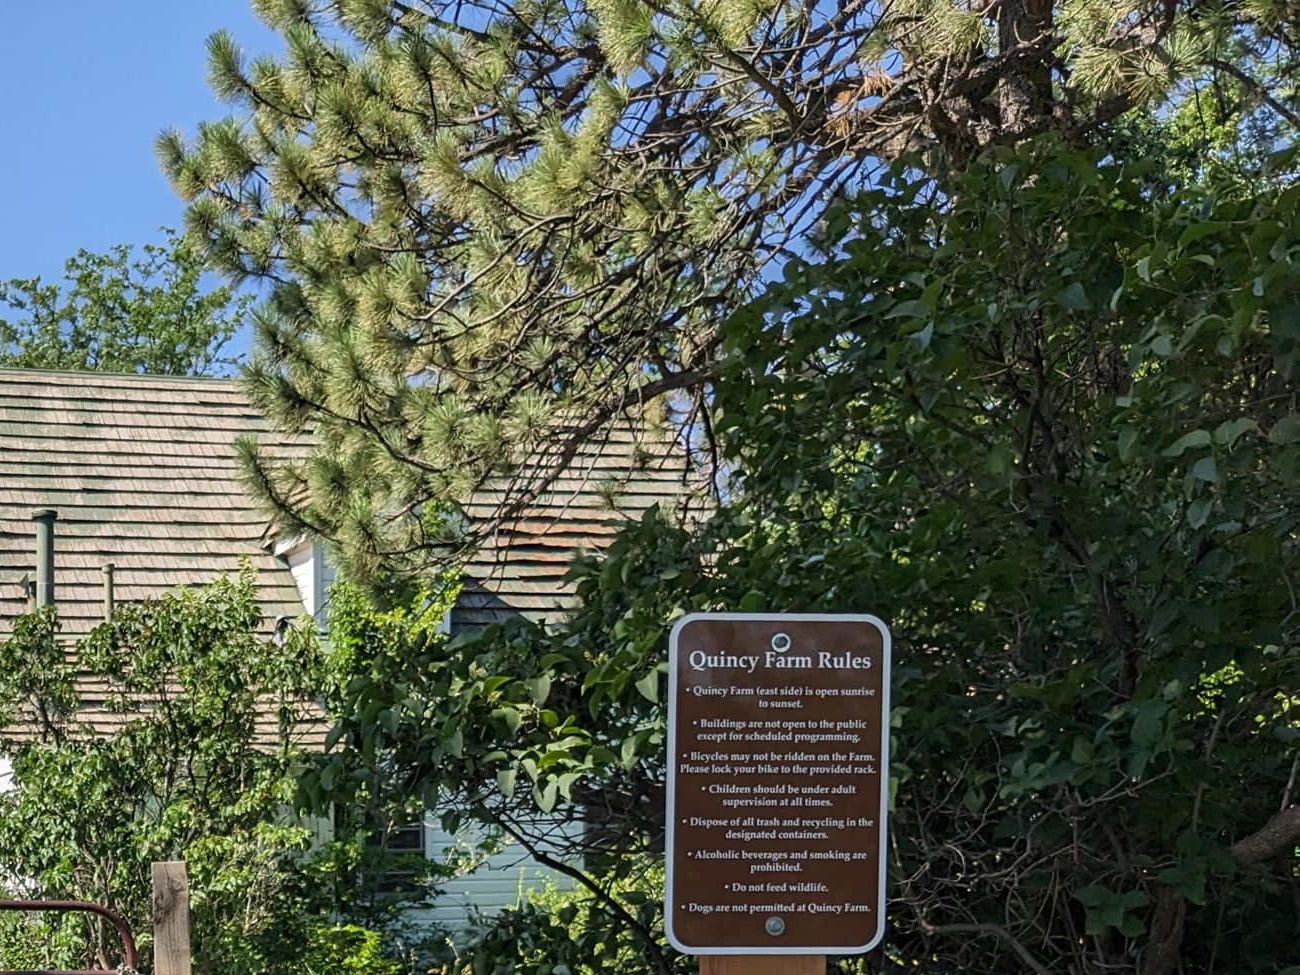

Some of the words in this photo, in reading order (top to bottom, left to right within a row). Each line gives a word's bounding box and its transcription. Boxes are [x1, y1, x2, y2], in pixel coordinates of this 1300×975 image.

[689, 651, 759, 673] Quincy
[764, 652, 812, 668] Farm
[818, 652, 871, 668] Rules
[693, 686, 727, 697] Quincy
[730, 686, 754, 694] Farm
[756, 687, 778, 695] (east
[780, 687, 802, 695] side)
[805, 687, 813, 695] is
[815, 689, 838, 698] open
[841, 687, 875, 695] sunrise
[770, 700, 803, 708] sunset.
[700, 719, 746, 730] Buildings
[765, 720, 780, 728] not
[782, 722, 806, 730] open
[819, 720, 834, 728] the
[836, 720, 866, 730] public
[697, 733, 727, 743] except
[729, 732, 743, 740] for
[745, 732, 792, 740] scheduled
[794, 732, 860, 743] programming.
[690, 752, 728, 763] Bicycles
[730, 754, 750, 763] may
[753, 753, 768, 761] not
[770, 752, 782, 760] be
[784, 752, 815, 761] ridden
[832, 752, 847, 761] the
[849, 753, 875, 761] Farm.
[680, 764, 709, 773] Please
[712, 764, 731, 773] lock
[733, 767, 755, 775] your
[757, 764, 779, 773] bike
[792, 765, 807, 773] the
[810, 765, 852, 776] provided
[854, 765, 876, 773] rack.
[709, 785, 751, 793] Children
[753, 785, 785, 793] should
[787, 785, 800, 793] be
[802, 785, 829, 793] under
[831, 785, 856, 793] adult
[723, 797, 777, 808] supervision
[780, 798, 788, 806] at
[791, 797, 803, 806] all
[805, 798, 833, 806] times.
[690, 817, 728, 828] Dispose
[730, 818, 741, 826] of
[742, 818, 754, 826] all
[756, 818, 780, 826] trash
[782, 818, 800, 826] and
[802, 818, 844, 829] recycling
[847, 818, 856, 826] in
[858, 818, 873, 826] the
[725, 830, 776, 841] designated
[778, 830, 829, 838] containers.
[694, 850, 740, 859] Alcoholic
[742, 850, 788, 861] beverages
[790, 850, 807, 859] and
[810, 850, 850, 861] smoking
[751, 863, 803, 873] prohibited.
[732, 883, 746, 891] Do
[766, 883, 787, 891] feed
[789, 883, 829, 891] wildlife.
[689, 903, 713, 914] Dogs
[750, 903, 794, 914] permitted
[808, 903, 843, 914] Quincy
[845, 903, 871, 911] Farm.
